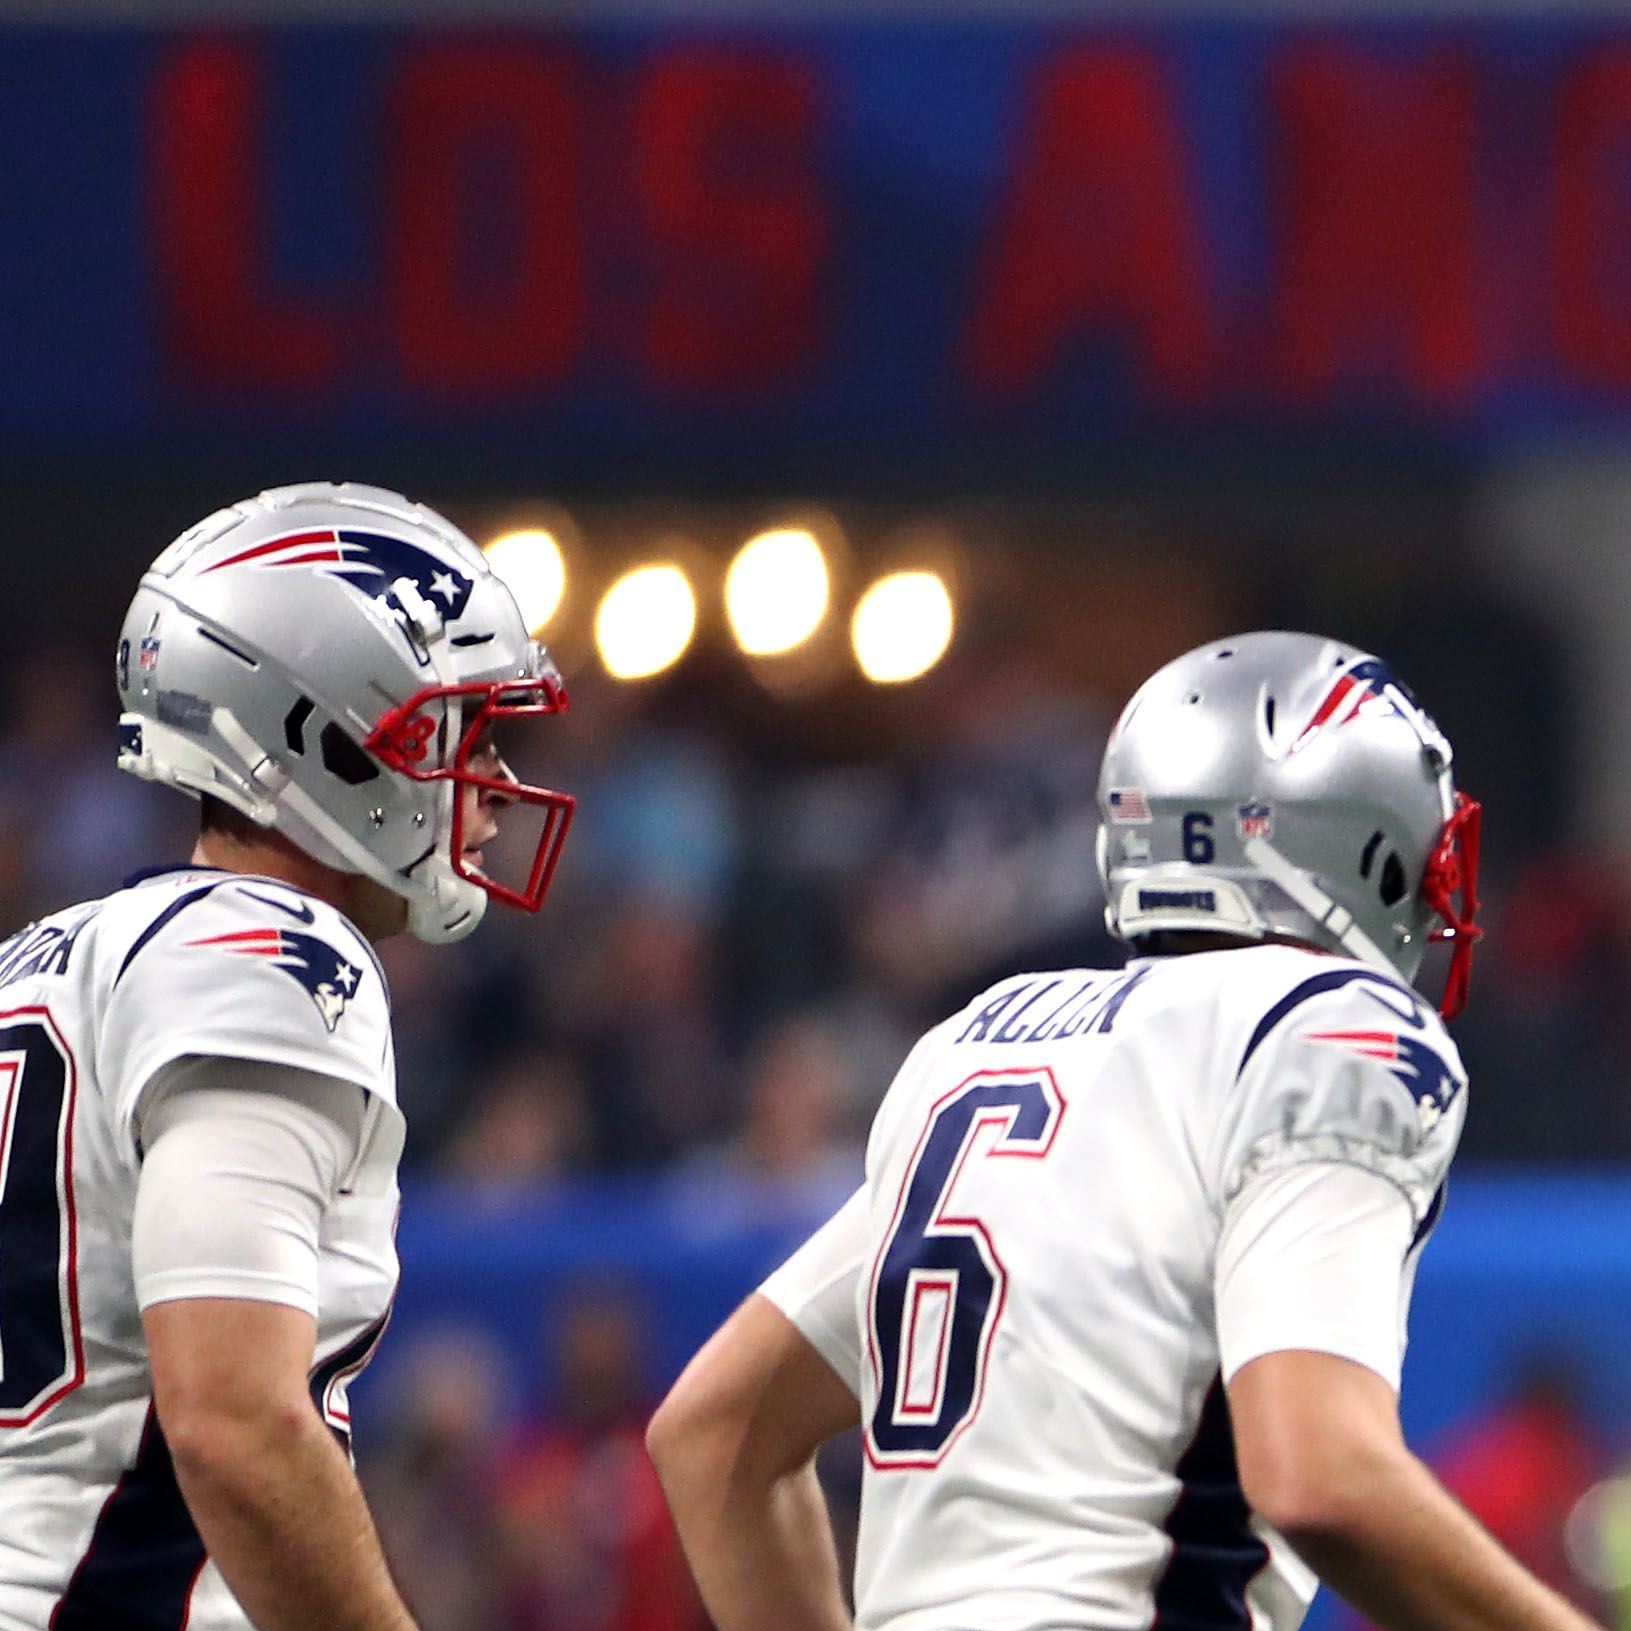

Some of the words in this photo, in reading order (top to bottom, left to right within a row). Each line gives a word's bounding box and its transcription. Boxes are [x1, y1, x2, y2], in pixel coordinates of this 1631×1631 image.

[150, 25, 838, 400] LOS
[1182, 811, 1215, 865] 6
[953, 964, 1153, 1045] ALLEN
[864, 1066, 1067, 1470] 6
